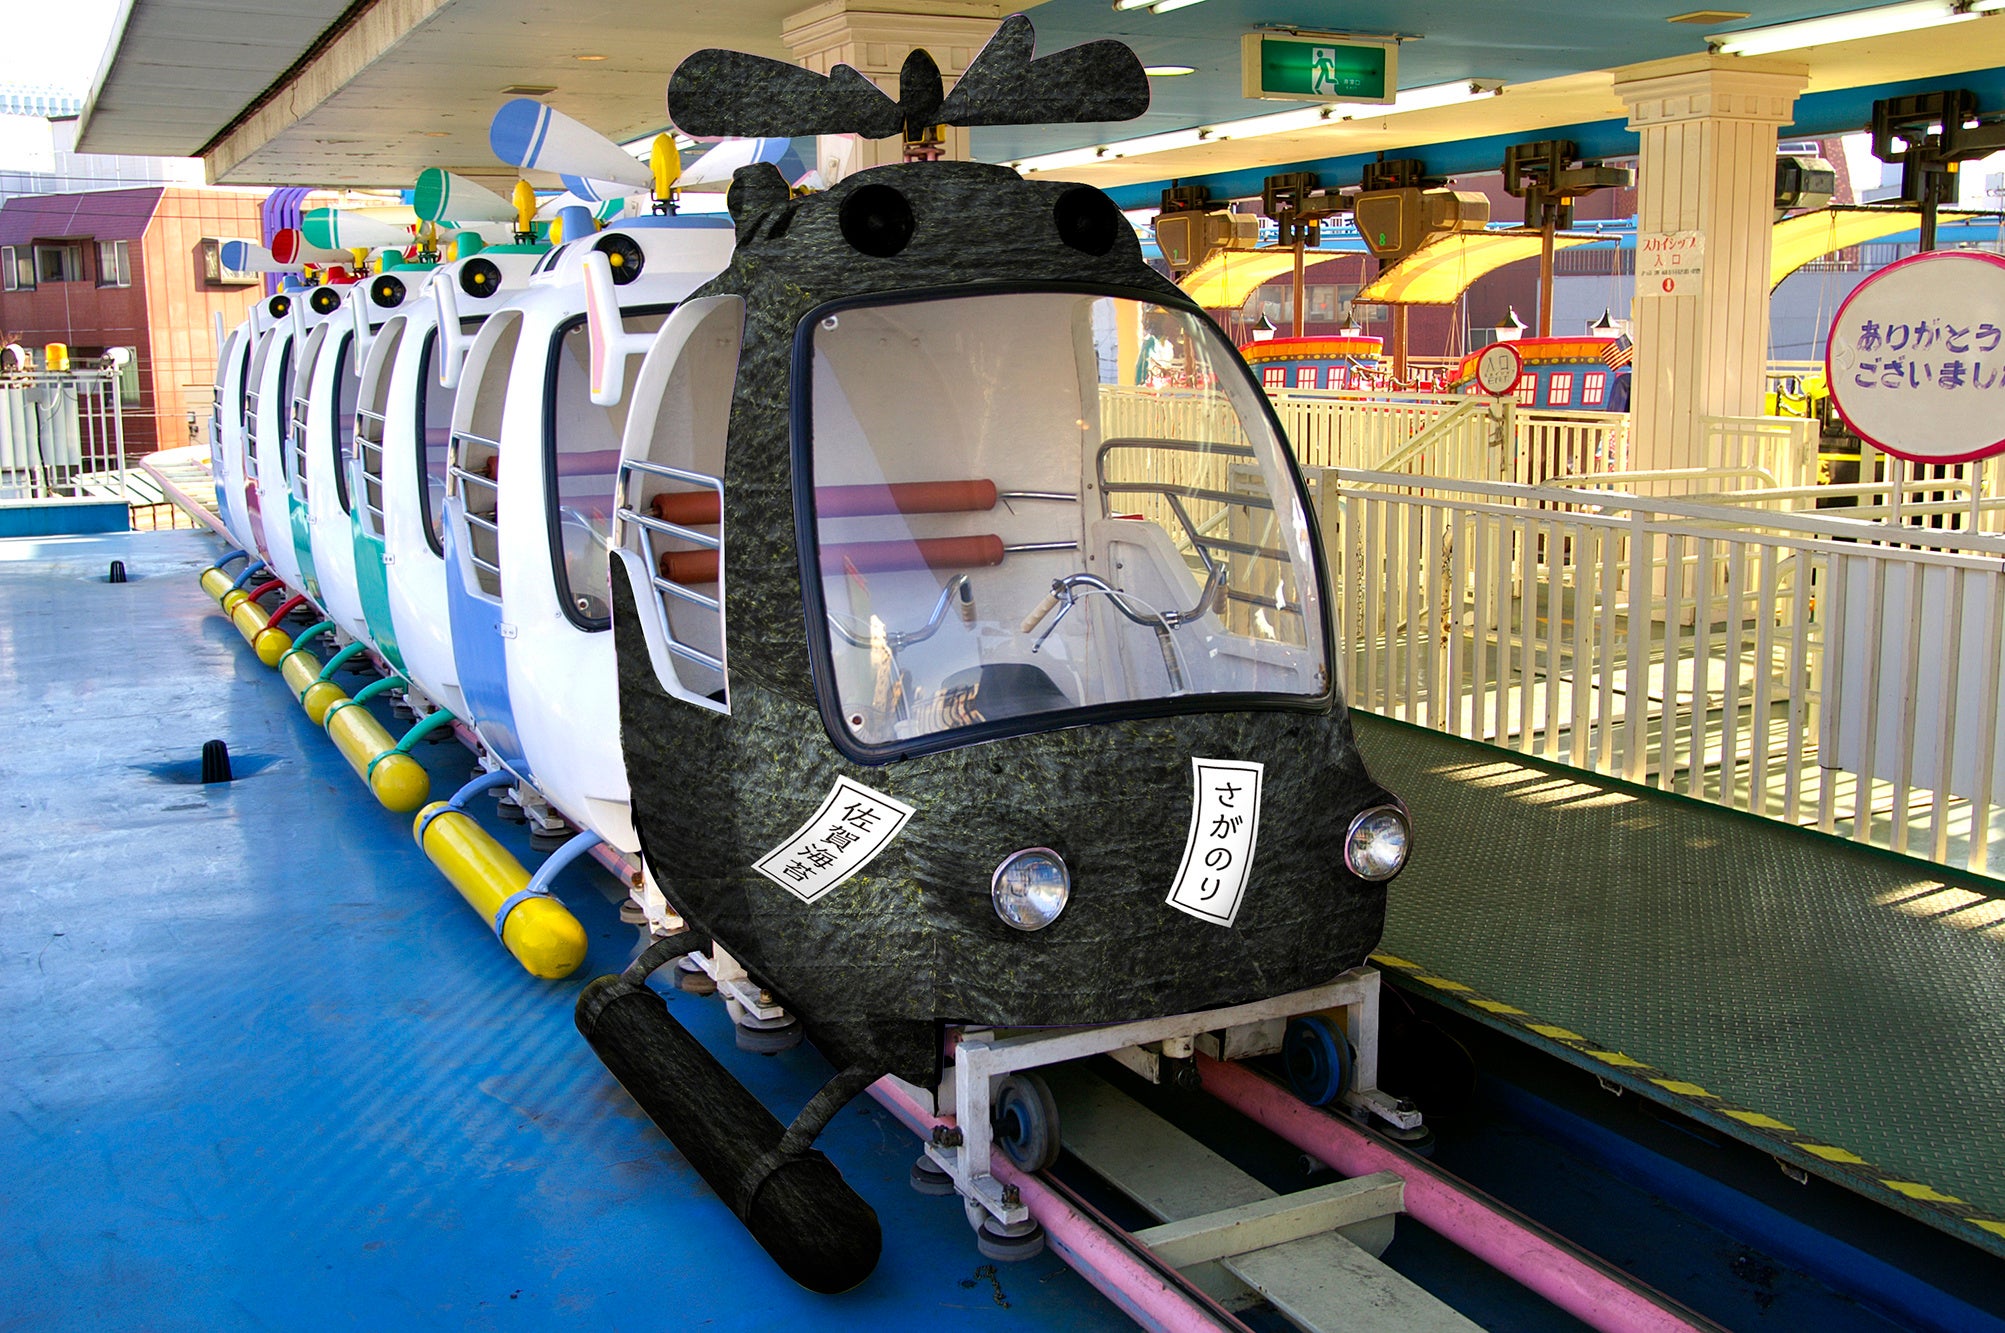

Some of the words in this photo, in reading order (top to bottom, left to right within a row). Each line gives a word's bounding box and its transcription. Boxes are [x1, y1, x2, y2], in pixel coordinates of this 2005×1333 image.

[1379, 232, 1386, 246] 8
[1654, 253, 1681, 267] 入口
[1857, 318, 2002, 353] ありがとう
[1855, 355, 2005, 389] ございまし
[782, 802, 881, 882] 佐賀海苔
[1200, 782, 1243, 901] さがのり
